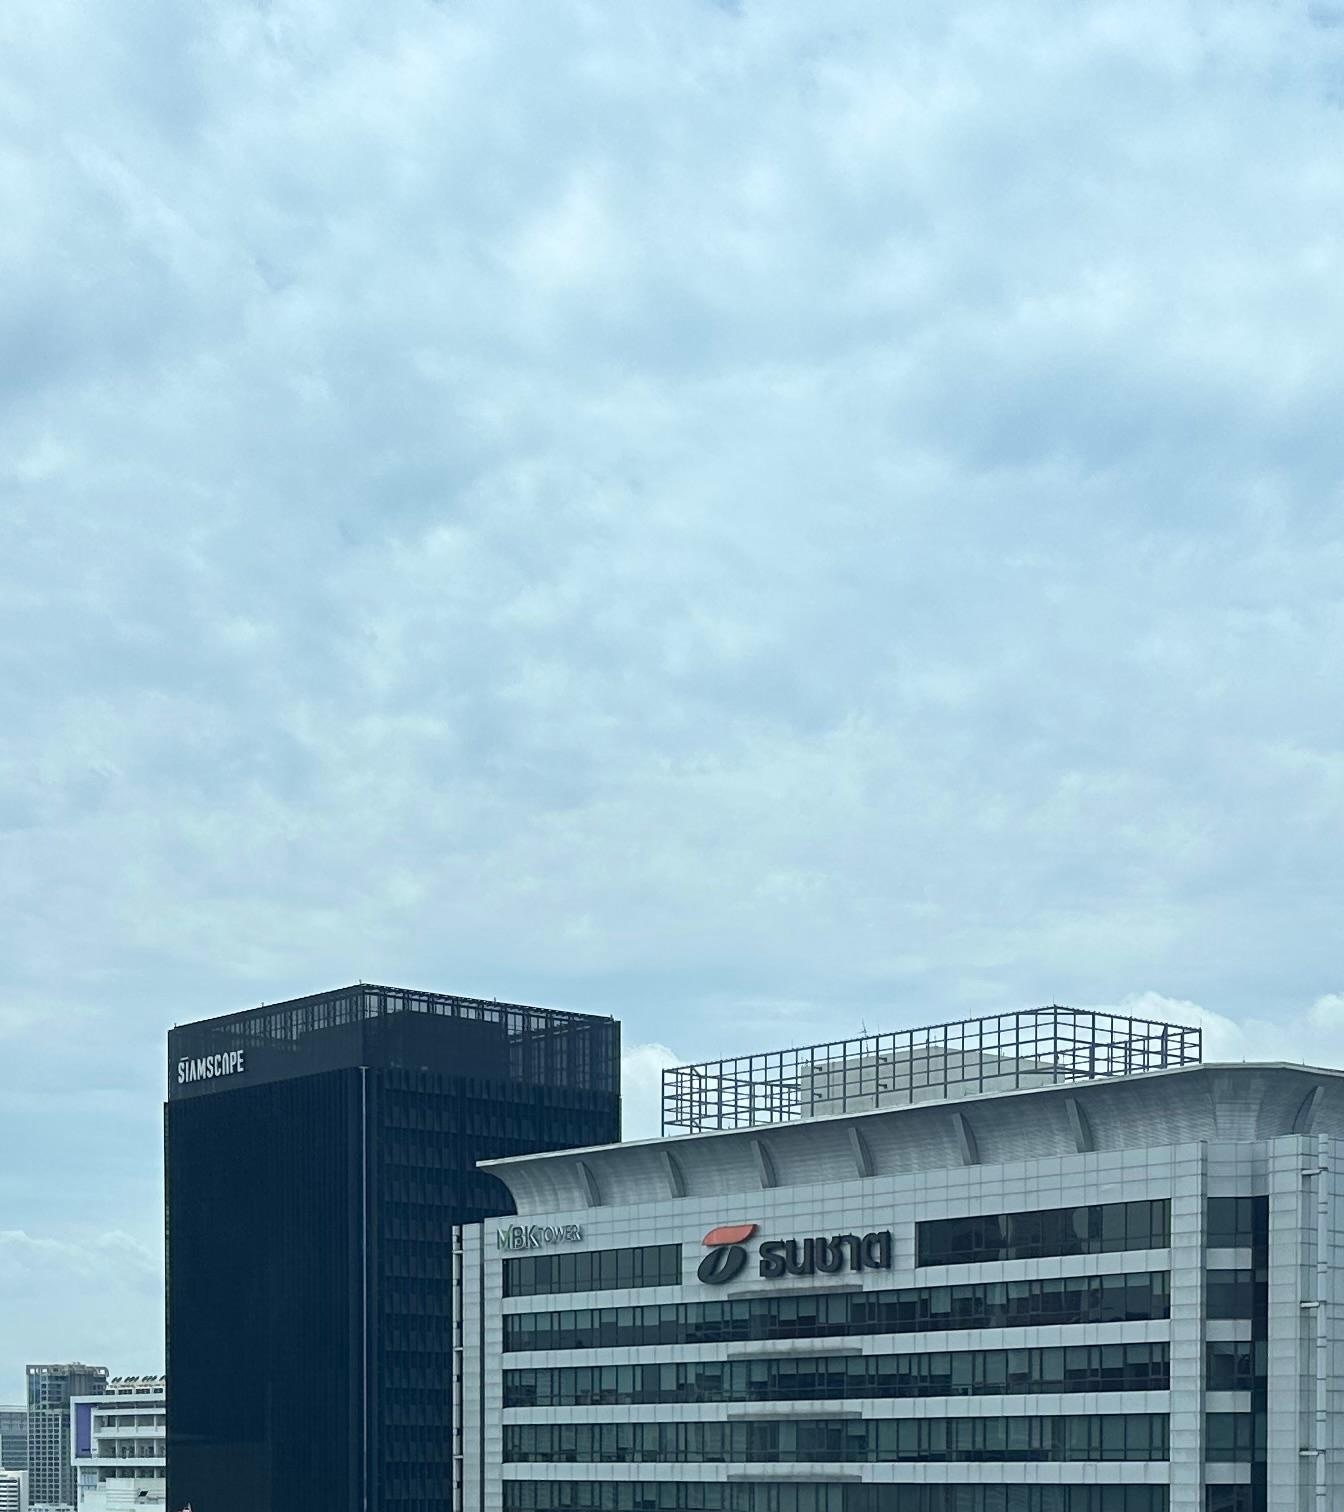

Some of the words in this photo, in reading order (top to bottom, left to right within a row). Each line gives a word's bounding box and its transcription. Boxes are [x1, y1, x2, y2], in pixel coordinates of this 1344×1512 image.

[177, 1050, 245, 1084] SIAMSCAPE
[497, 1224, 540, 1250] MBK
[538, 1225, 583, 1243] TOWER
[759, 1230, 892, 1278] ธนชาต
